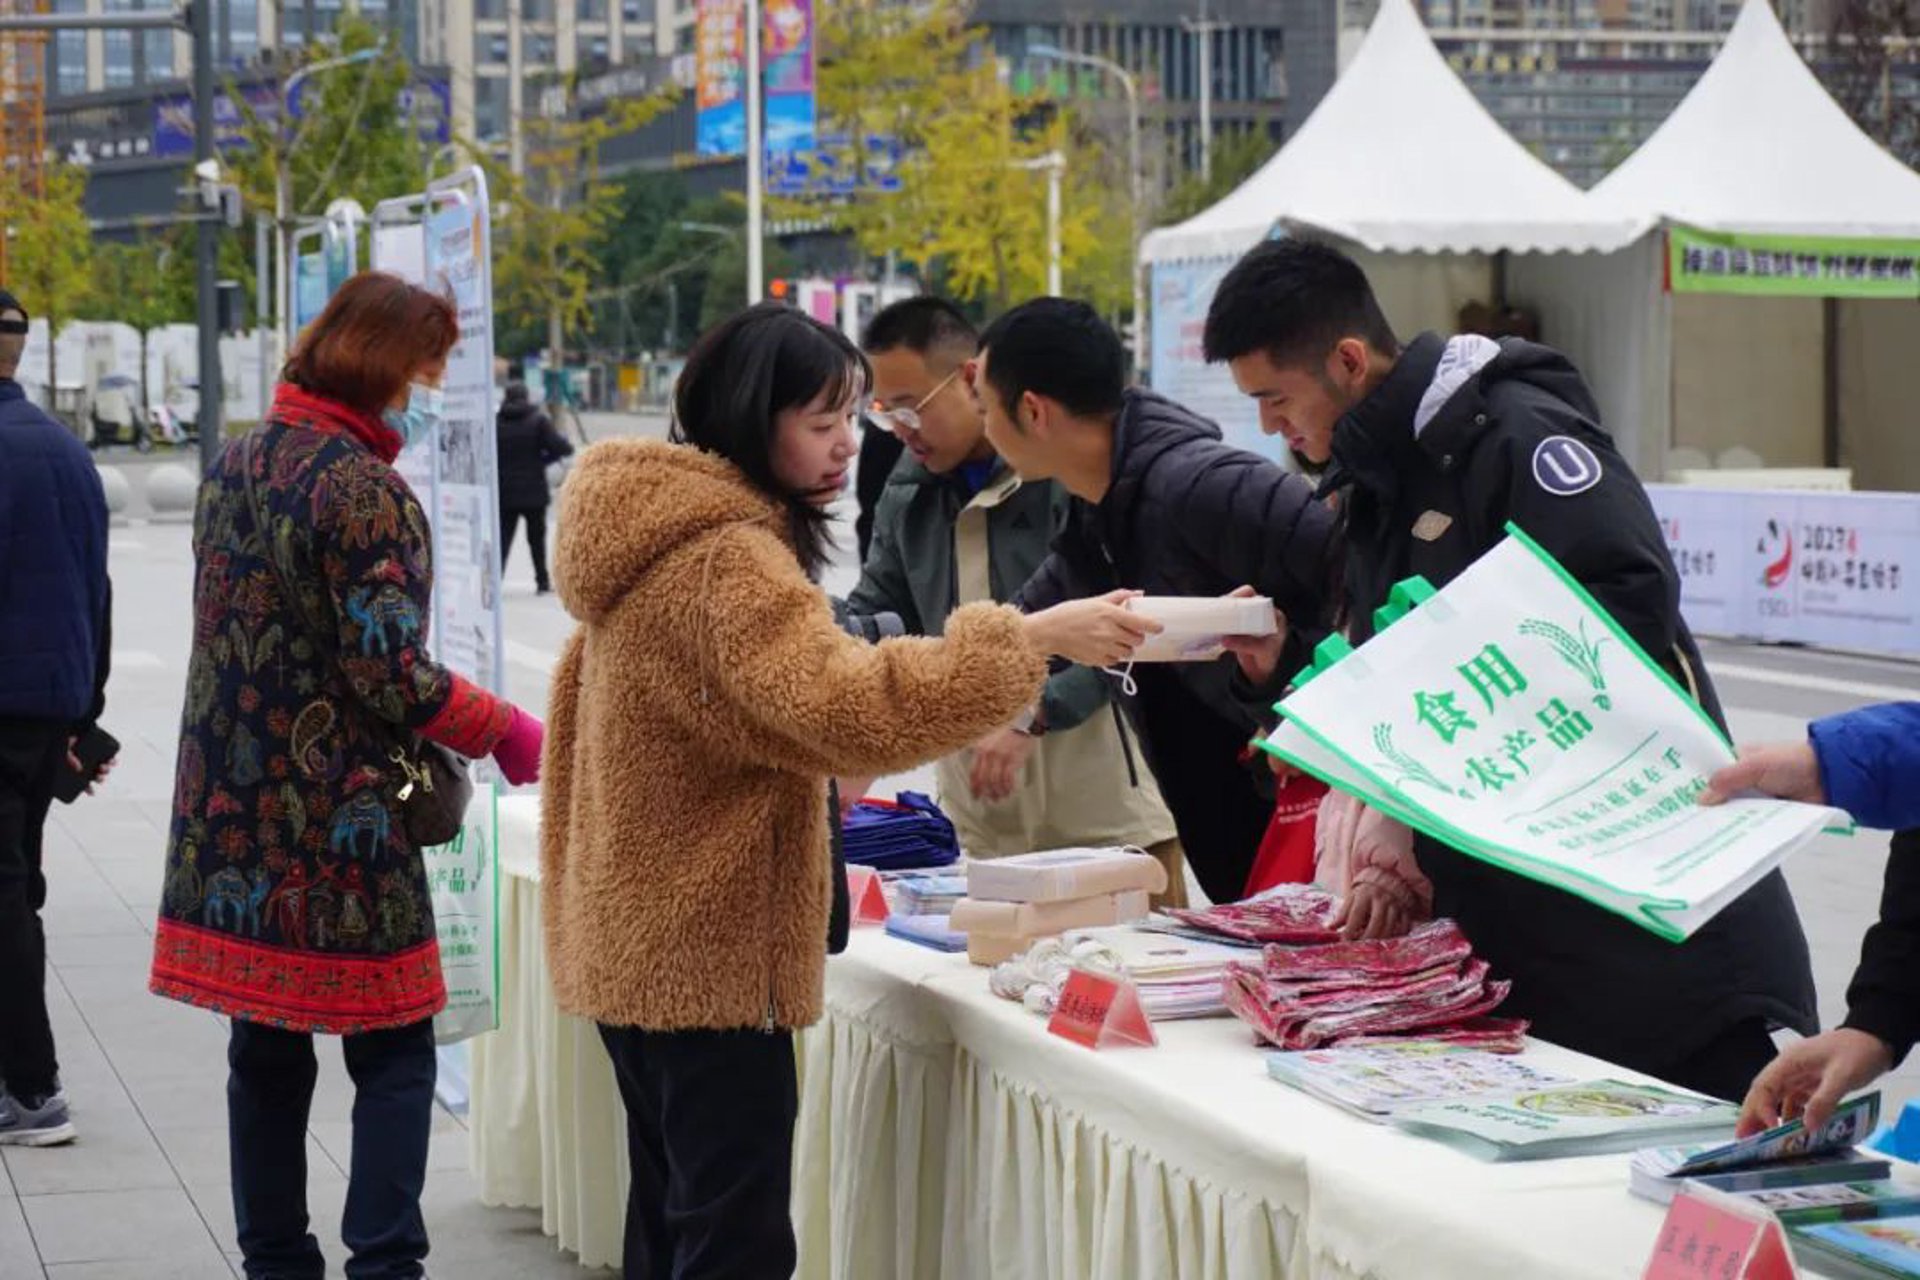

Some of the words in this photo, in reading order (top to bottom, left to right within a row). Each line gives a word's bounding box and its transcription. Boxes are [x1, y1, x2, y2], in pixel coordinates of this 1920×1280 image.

[1541, 442, 1590, 485] U
[1413, 643, 1528, 745] 食用
[1464, 697, 1594, 791] 农产品
